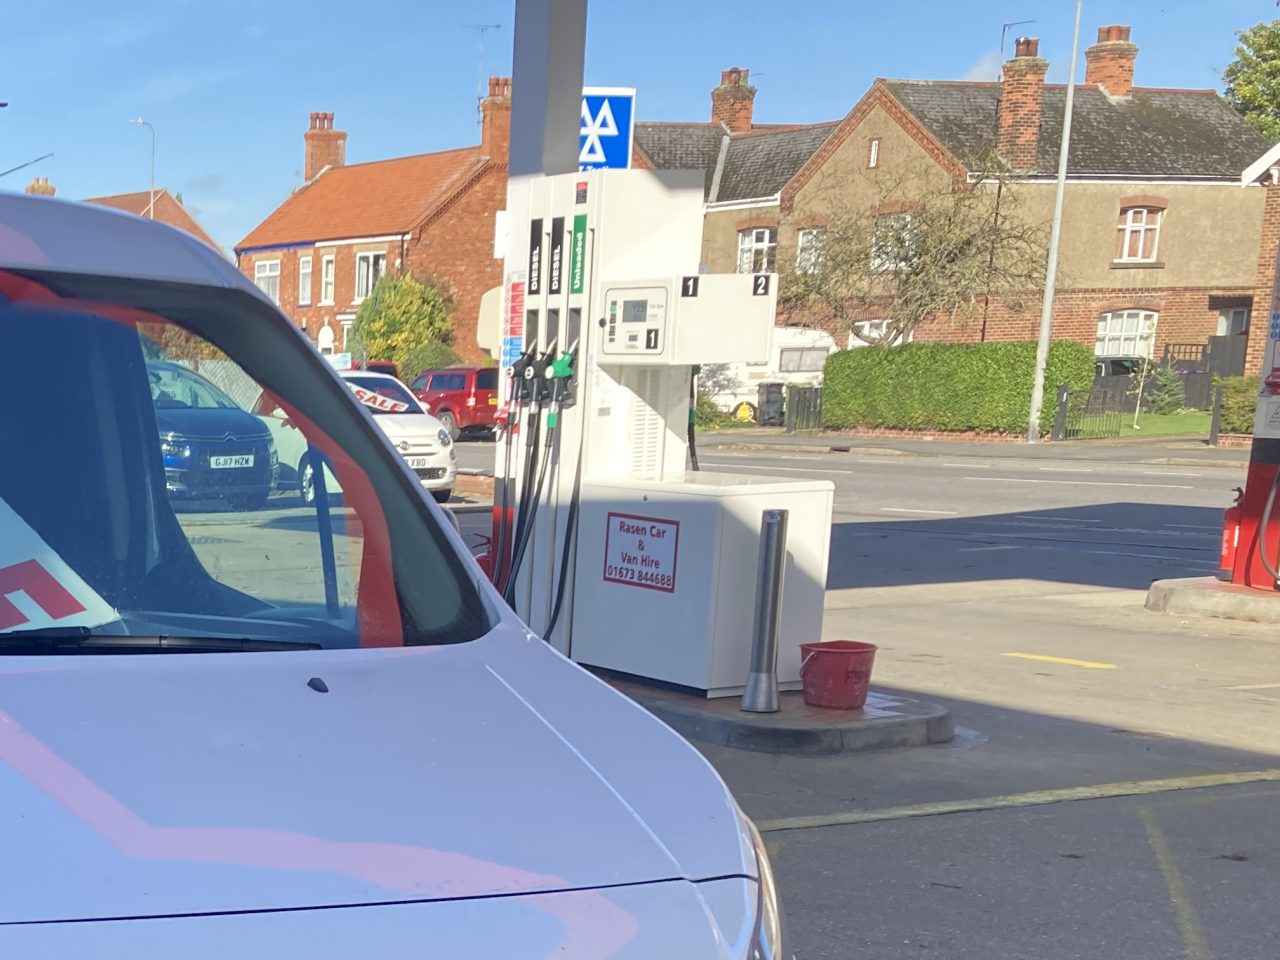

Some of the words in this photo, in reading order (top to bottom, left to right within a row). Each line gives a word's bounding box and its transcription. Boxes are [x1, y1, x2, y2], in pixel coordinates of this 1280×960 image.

[531, 245, 540, 290] DIESEL
[551, 244, 561, 290] DIESEL
[573, 231, 584, 289] Unleaded
[686, 278, 694, 296] 1
[756, 276, 766, 295] 2
[649, 330, 655, 348] 1
[354, 389, 405, 411] SALE
[619, 521, 647, 536] Rasen
[649, 525, 666, 539] Car
[638, 539, 645, 551] &
[621, 551, 638, 565] Van
[640, 554, 660, 569] Hire
[607, 564, 635, 580] 01673
